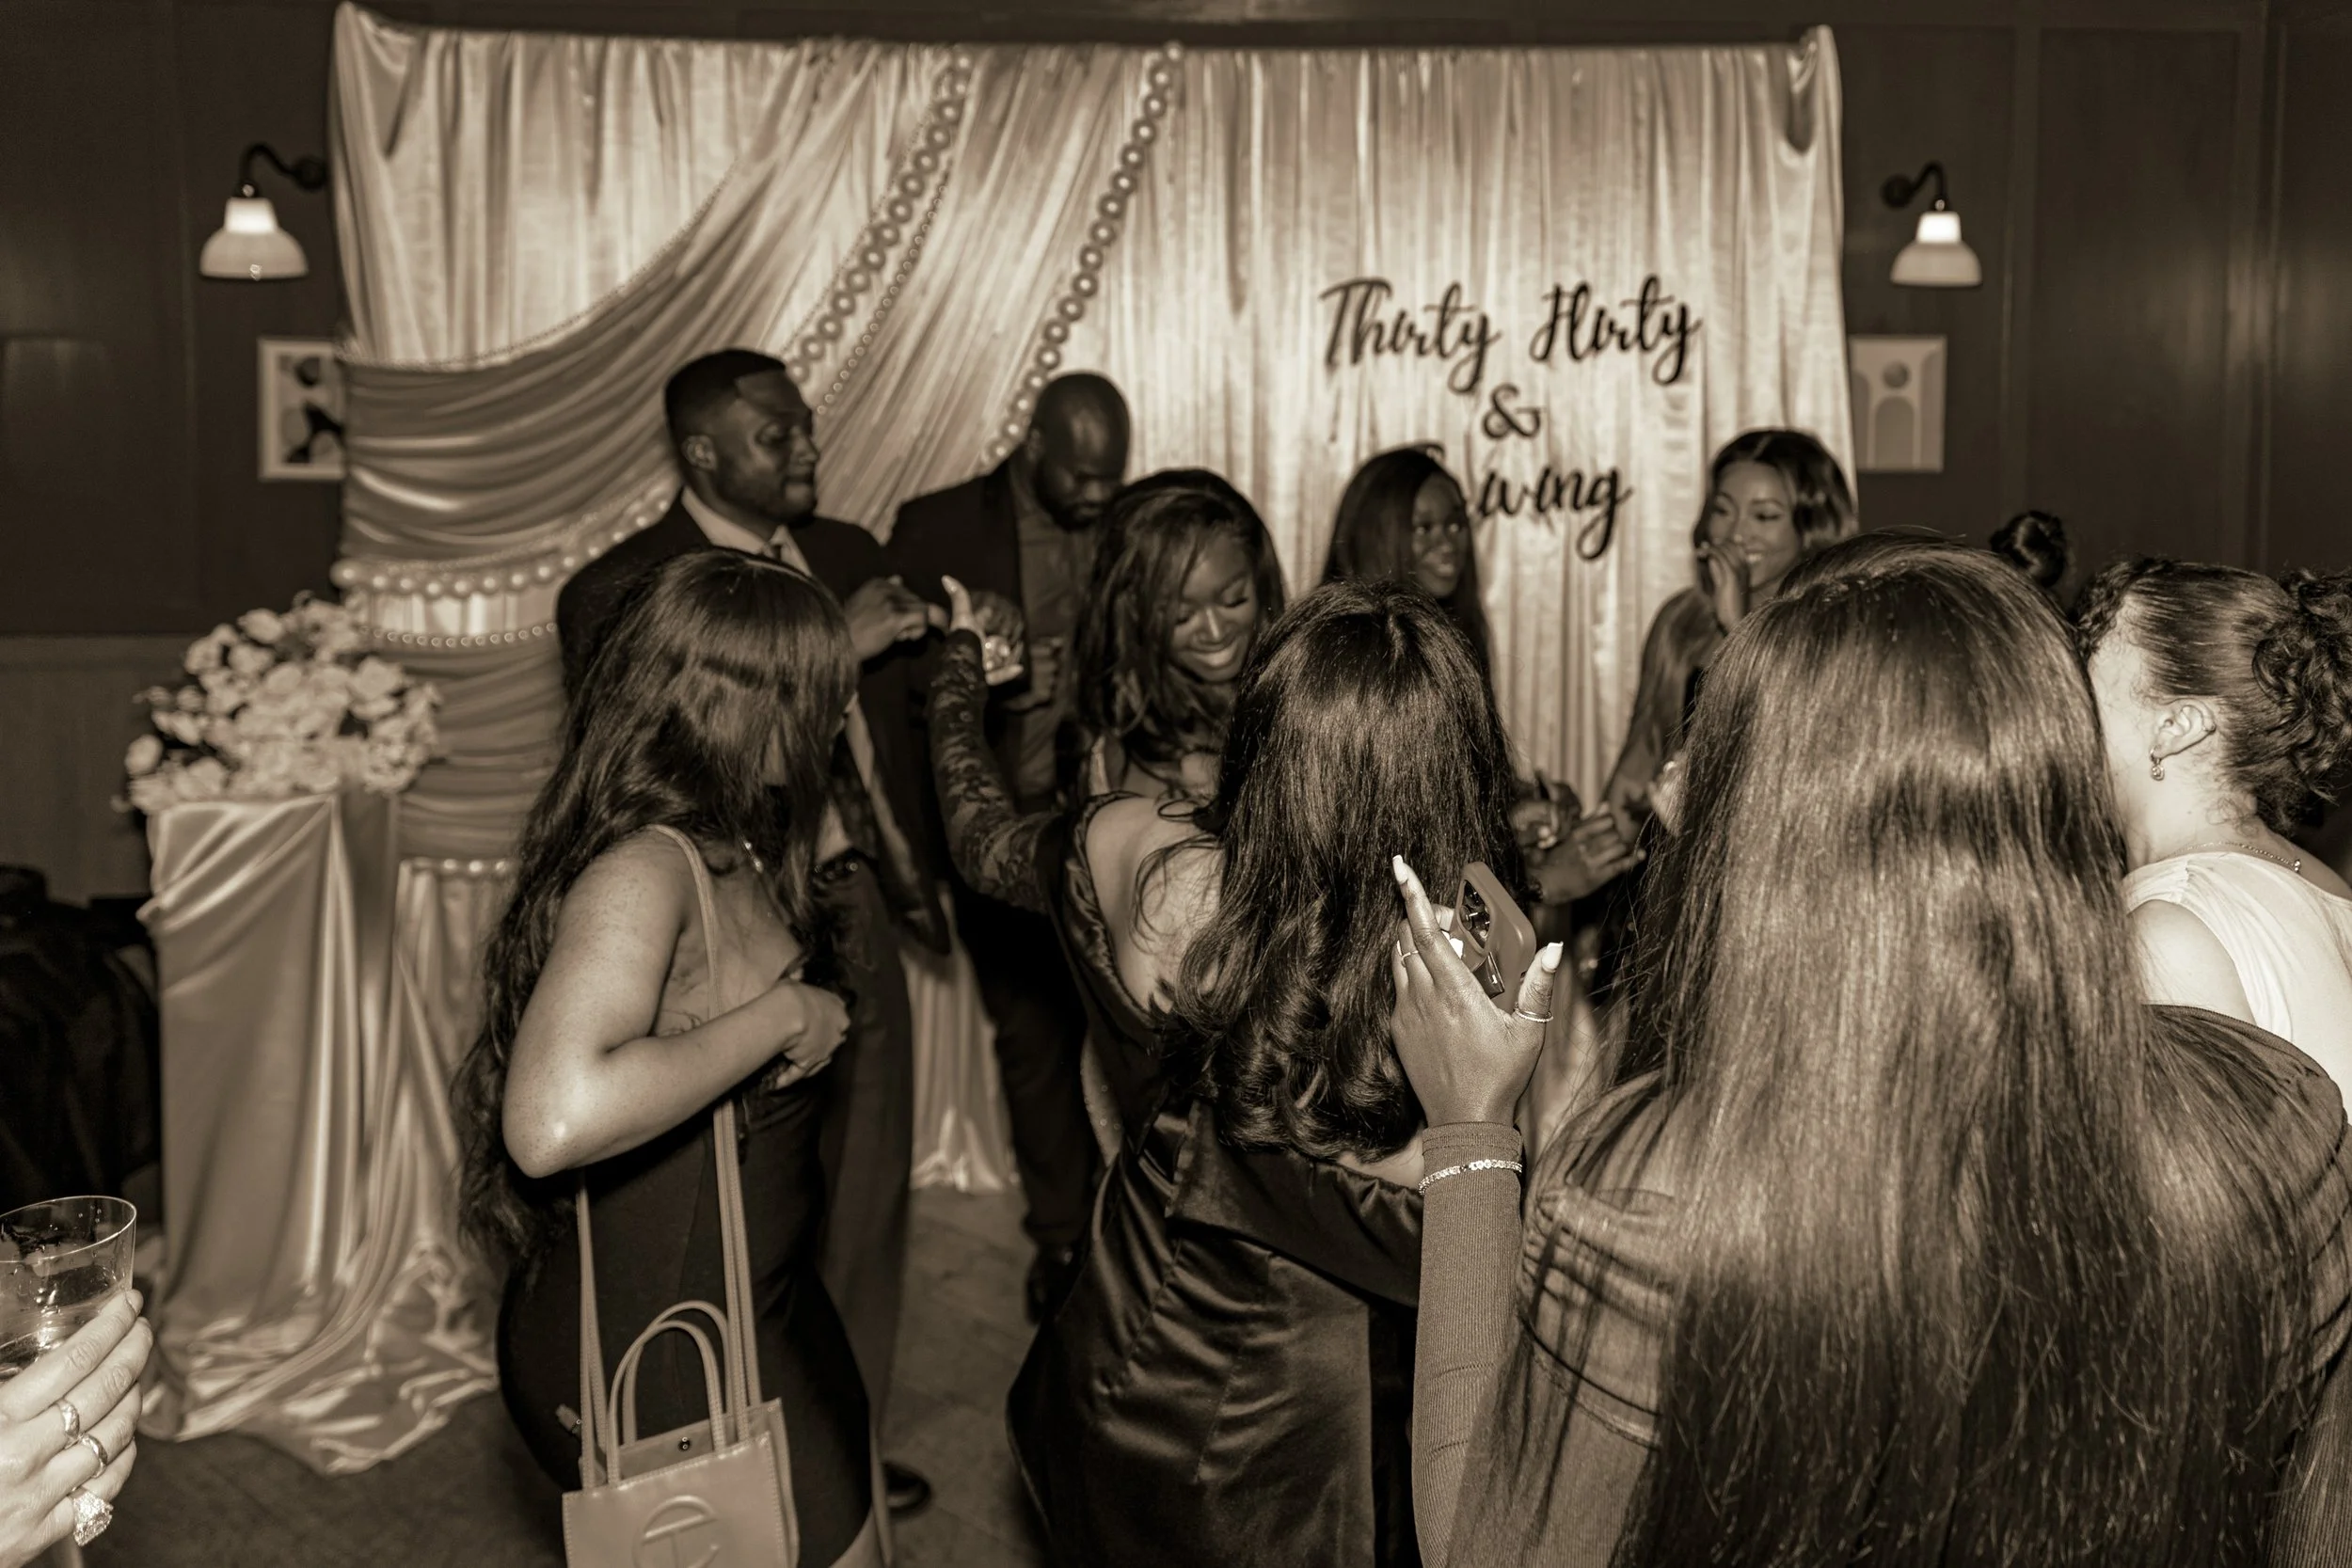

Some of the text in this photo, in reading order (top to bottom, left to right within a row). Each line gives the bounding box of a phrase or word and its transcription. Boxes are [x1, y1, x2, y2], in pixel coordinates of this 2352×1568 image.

[1319, 276, 1502, 395] Thirty
[1482, 383, 1542, 440] &
[1477, 466, 1634, 562] iving
